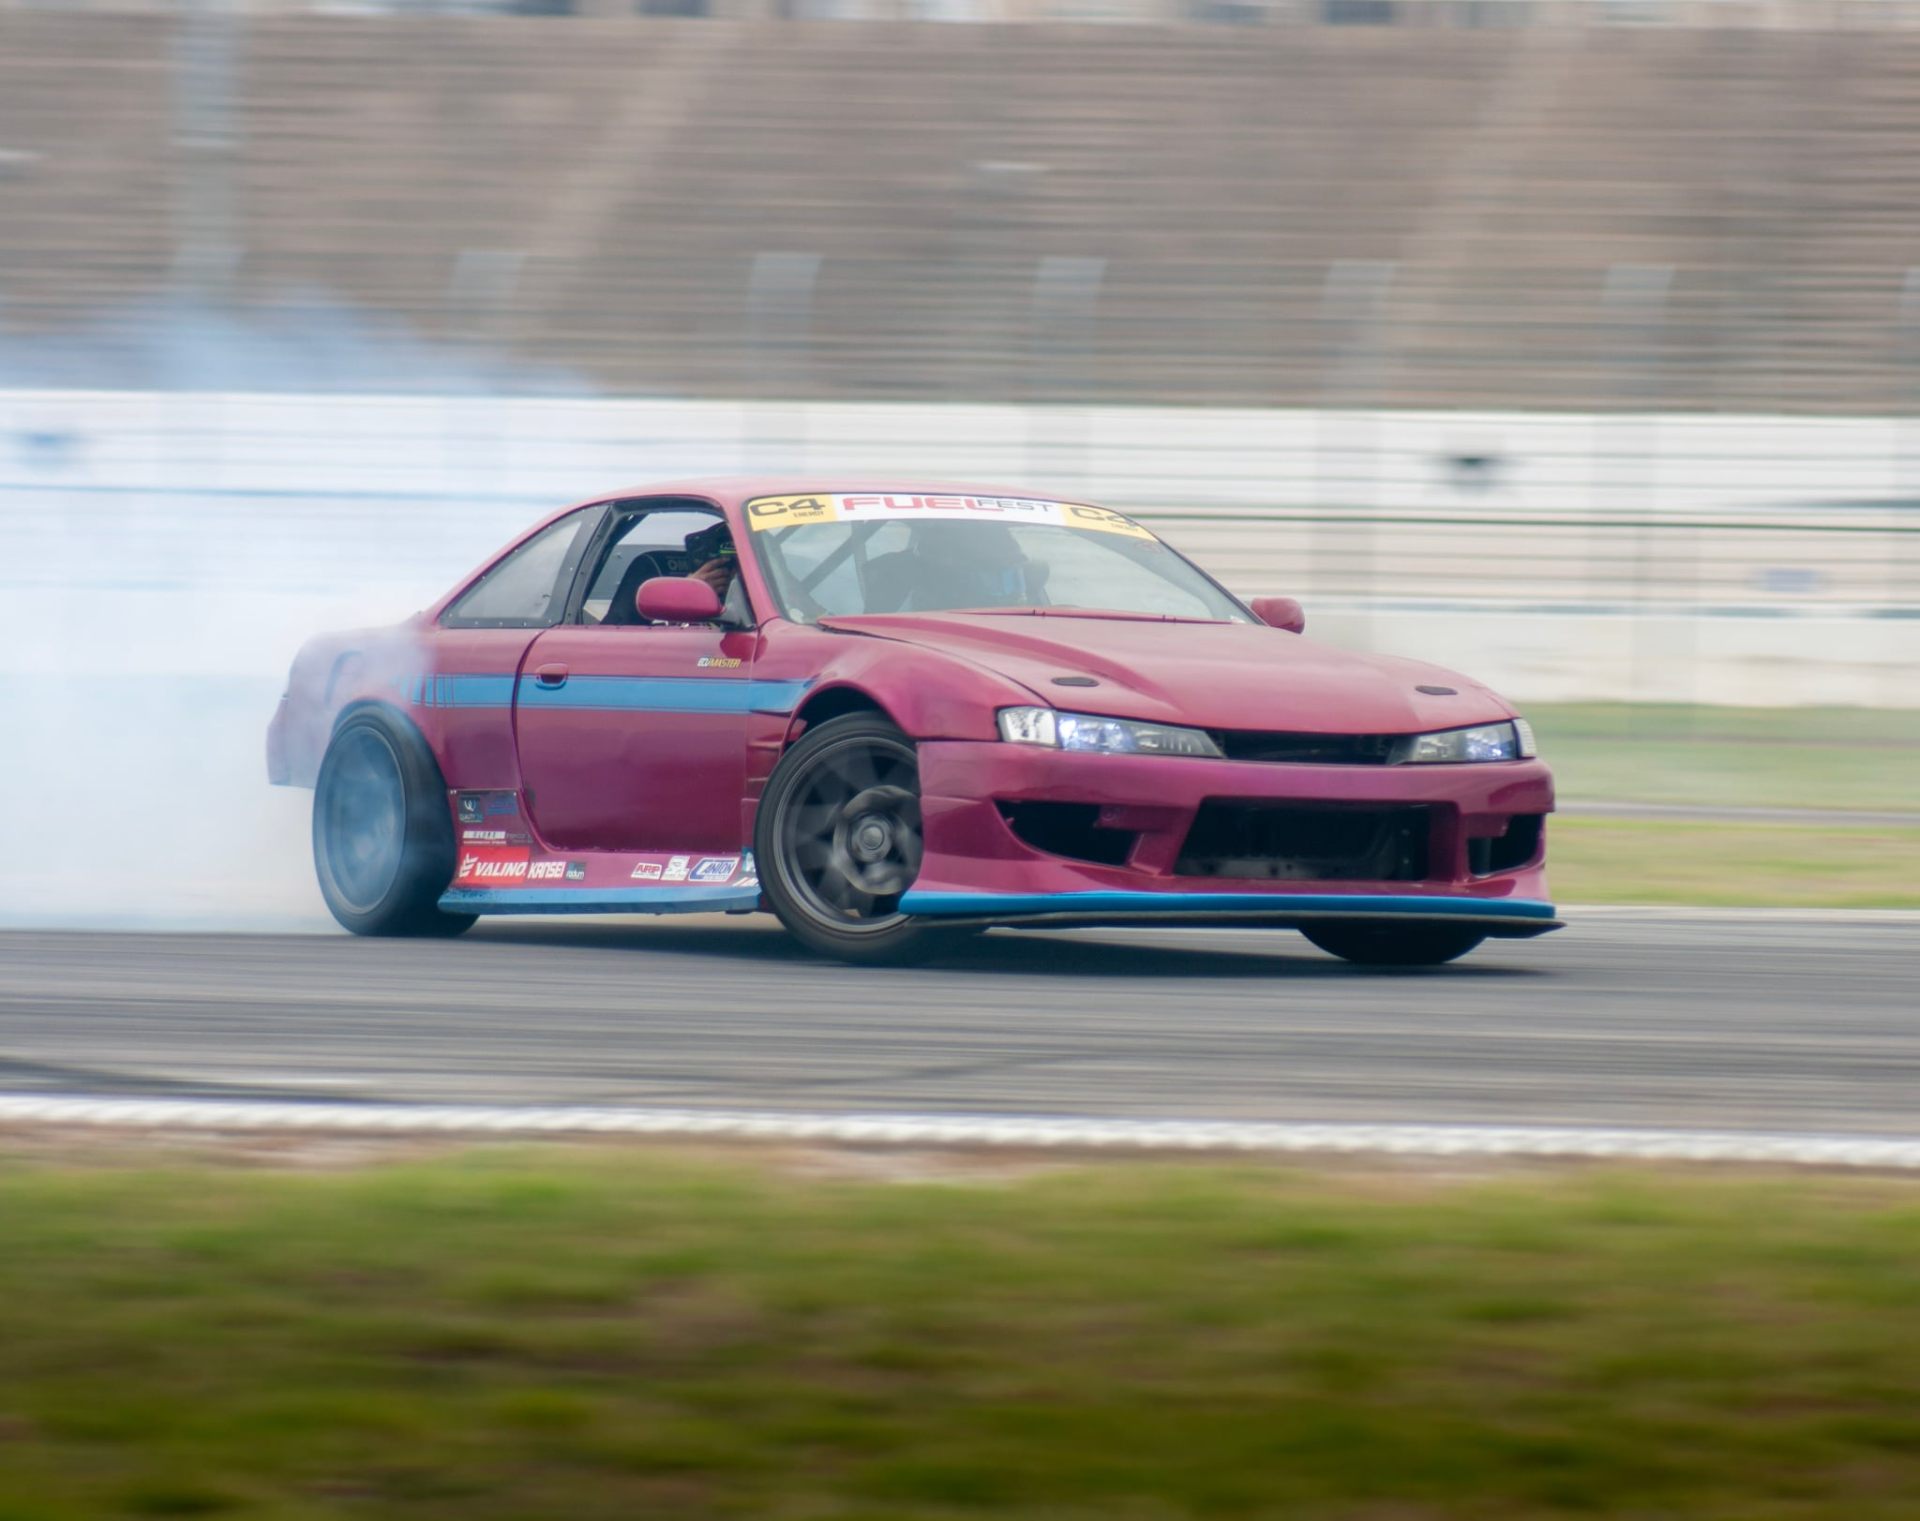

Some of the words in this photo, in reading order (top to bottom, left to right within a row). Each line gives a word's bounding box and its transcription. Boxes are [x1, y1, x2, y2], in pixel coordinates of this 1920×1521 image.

[749, 498, 824, 516] C4
[475, 862, 526, 876] VALINO
[528, 862, 566, 878] KANSEI
